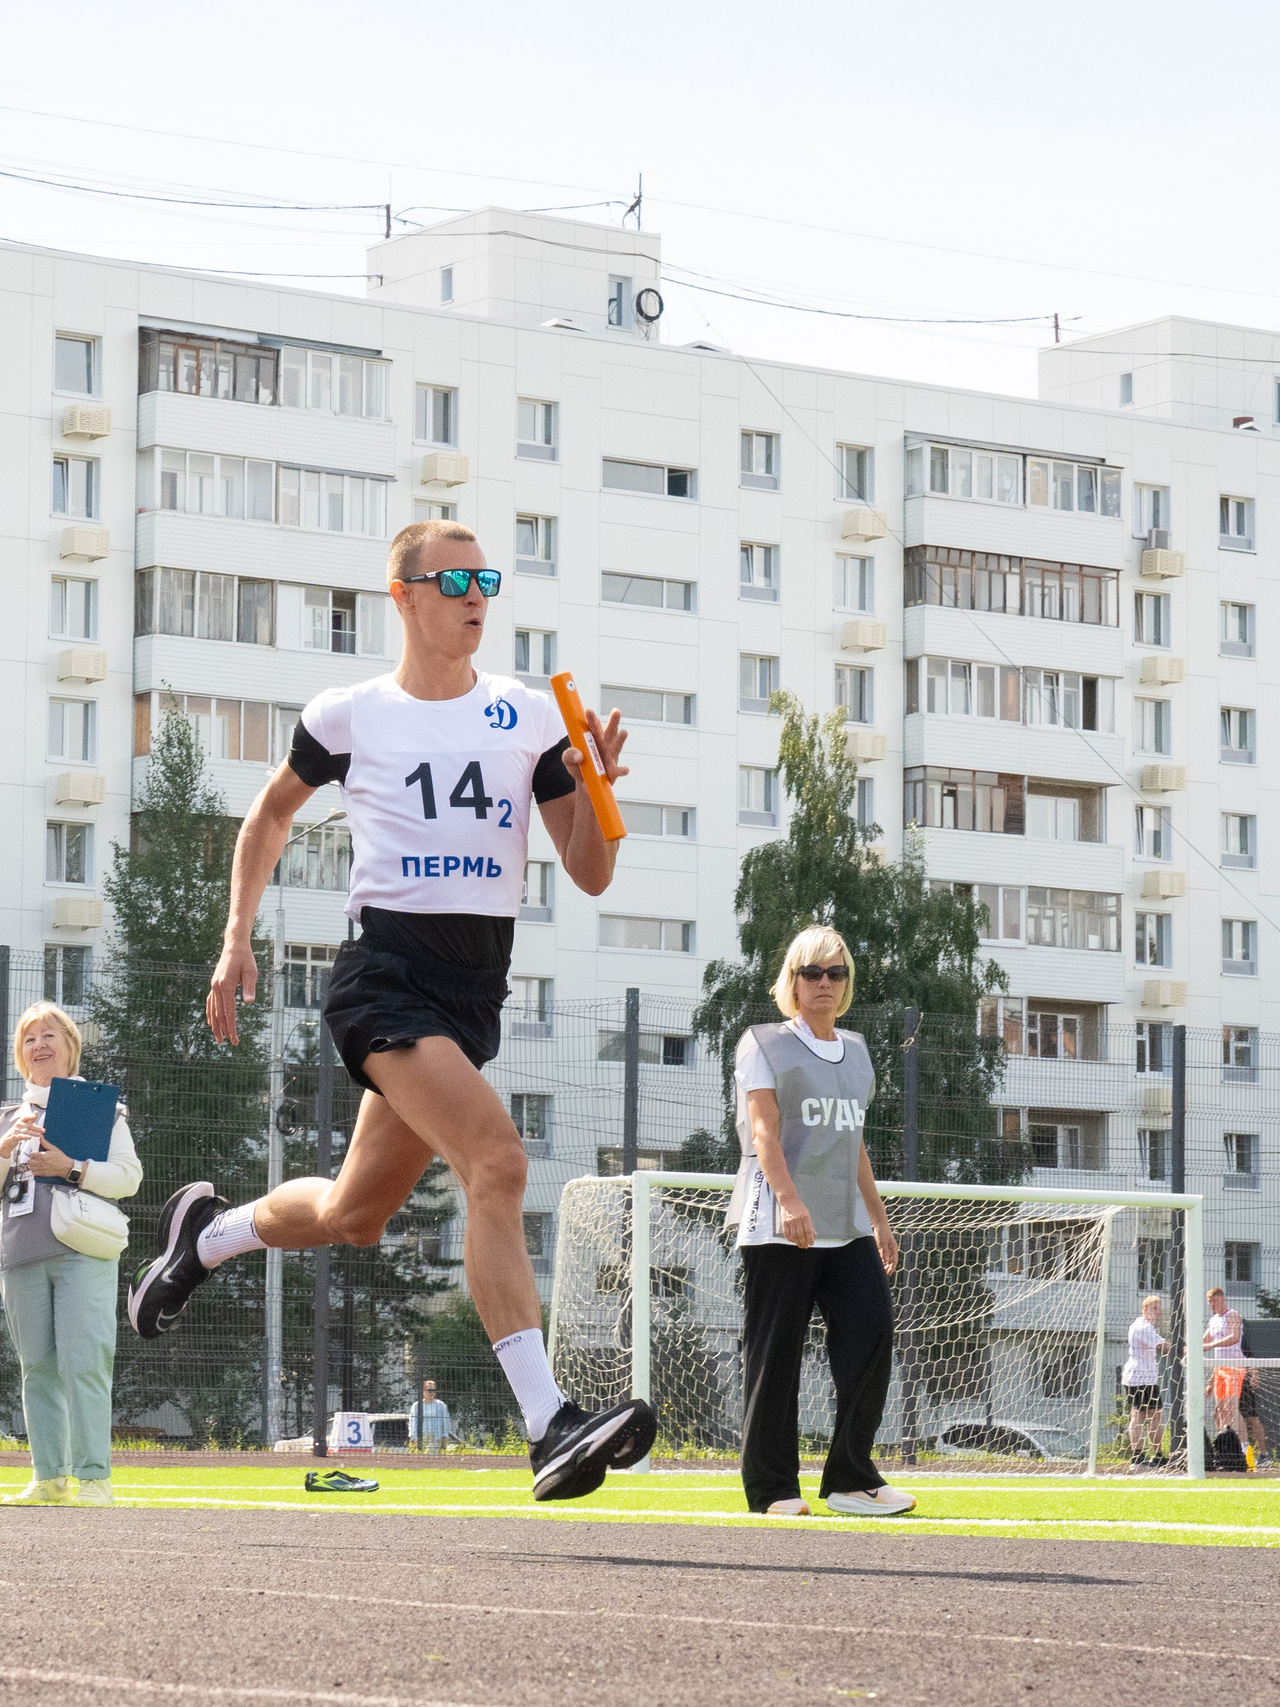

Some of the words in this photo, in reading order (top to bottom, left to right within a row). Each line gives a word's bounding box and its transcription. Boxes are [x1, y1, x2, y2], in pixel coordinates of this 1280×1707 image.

[405, 761, 493, 819] 14
[402, 856, 502, 878] ПЕРМЬ
[347, 1421, 362, 1445] 3
